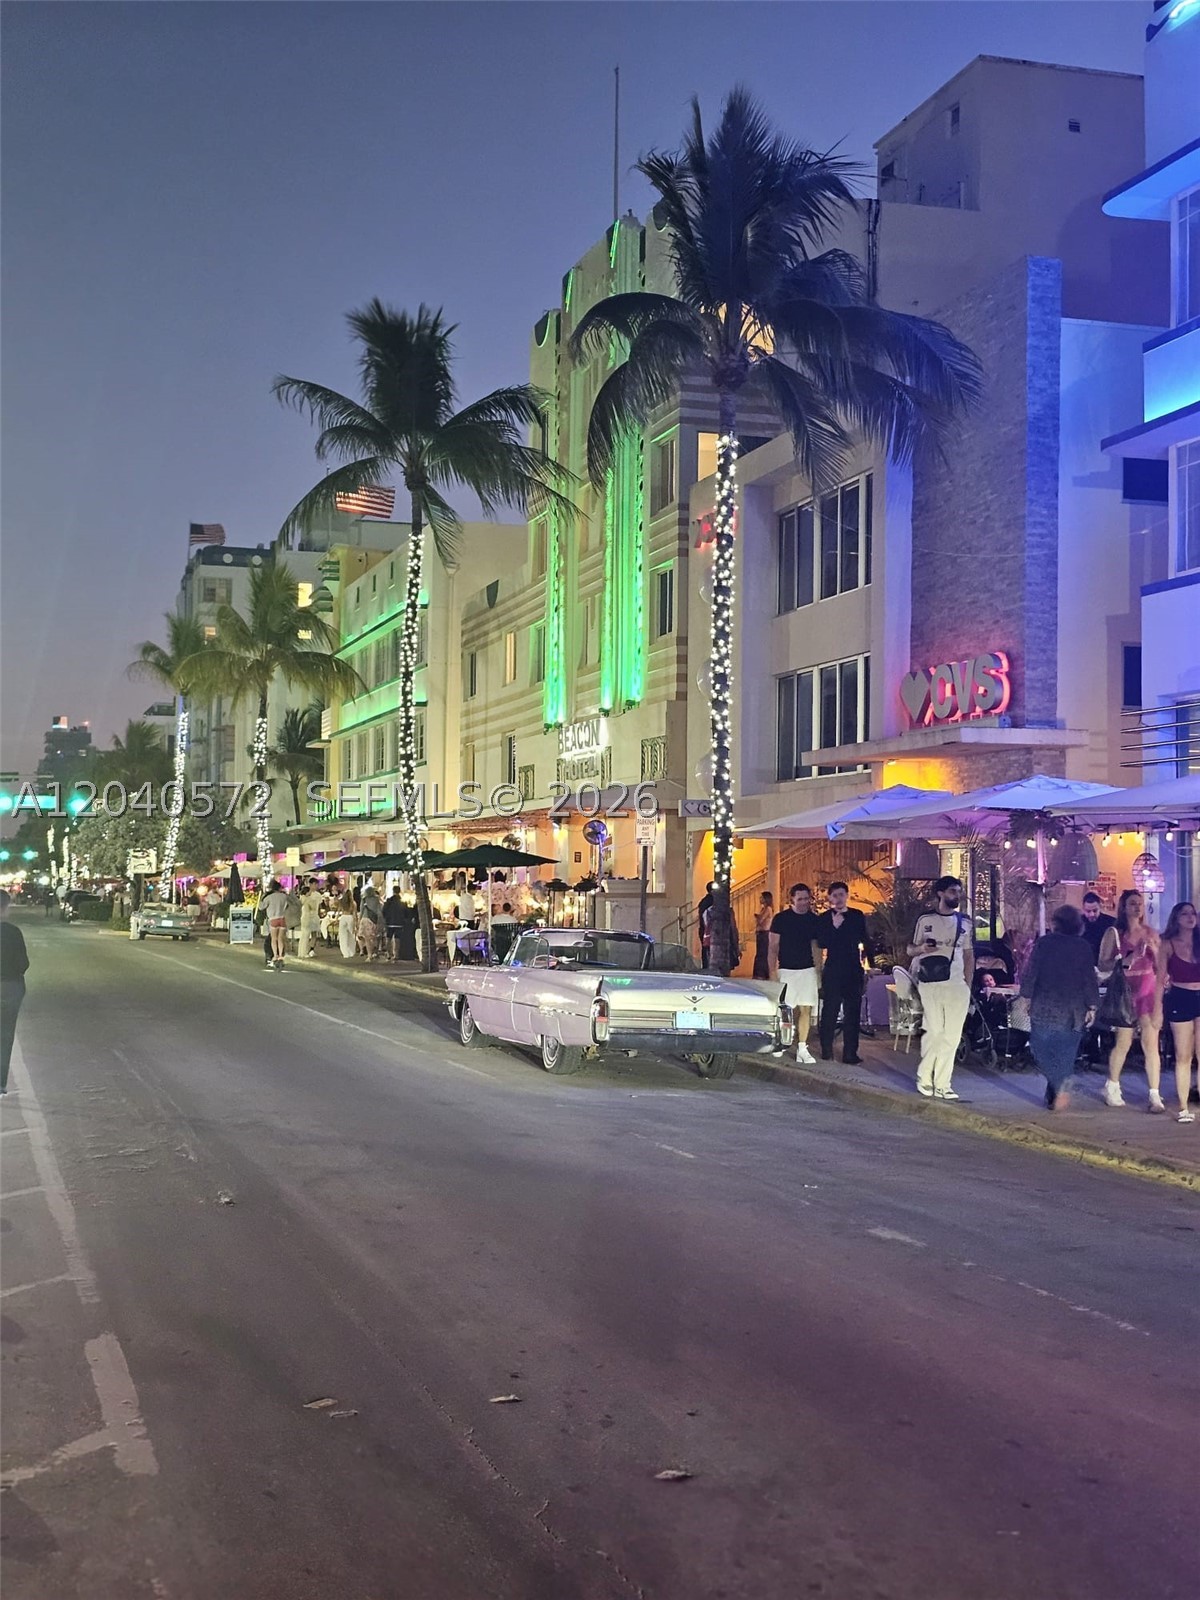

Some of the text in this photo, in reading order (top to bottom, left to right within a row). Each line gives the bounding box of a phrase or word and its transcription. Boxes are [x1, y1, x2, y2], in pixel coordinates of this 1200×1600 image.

[930, 652, 1009, 719] CVS
[557, 718, 601, 753] BEACON
[564, 754, 600, 781] HOTEL
